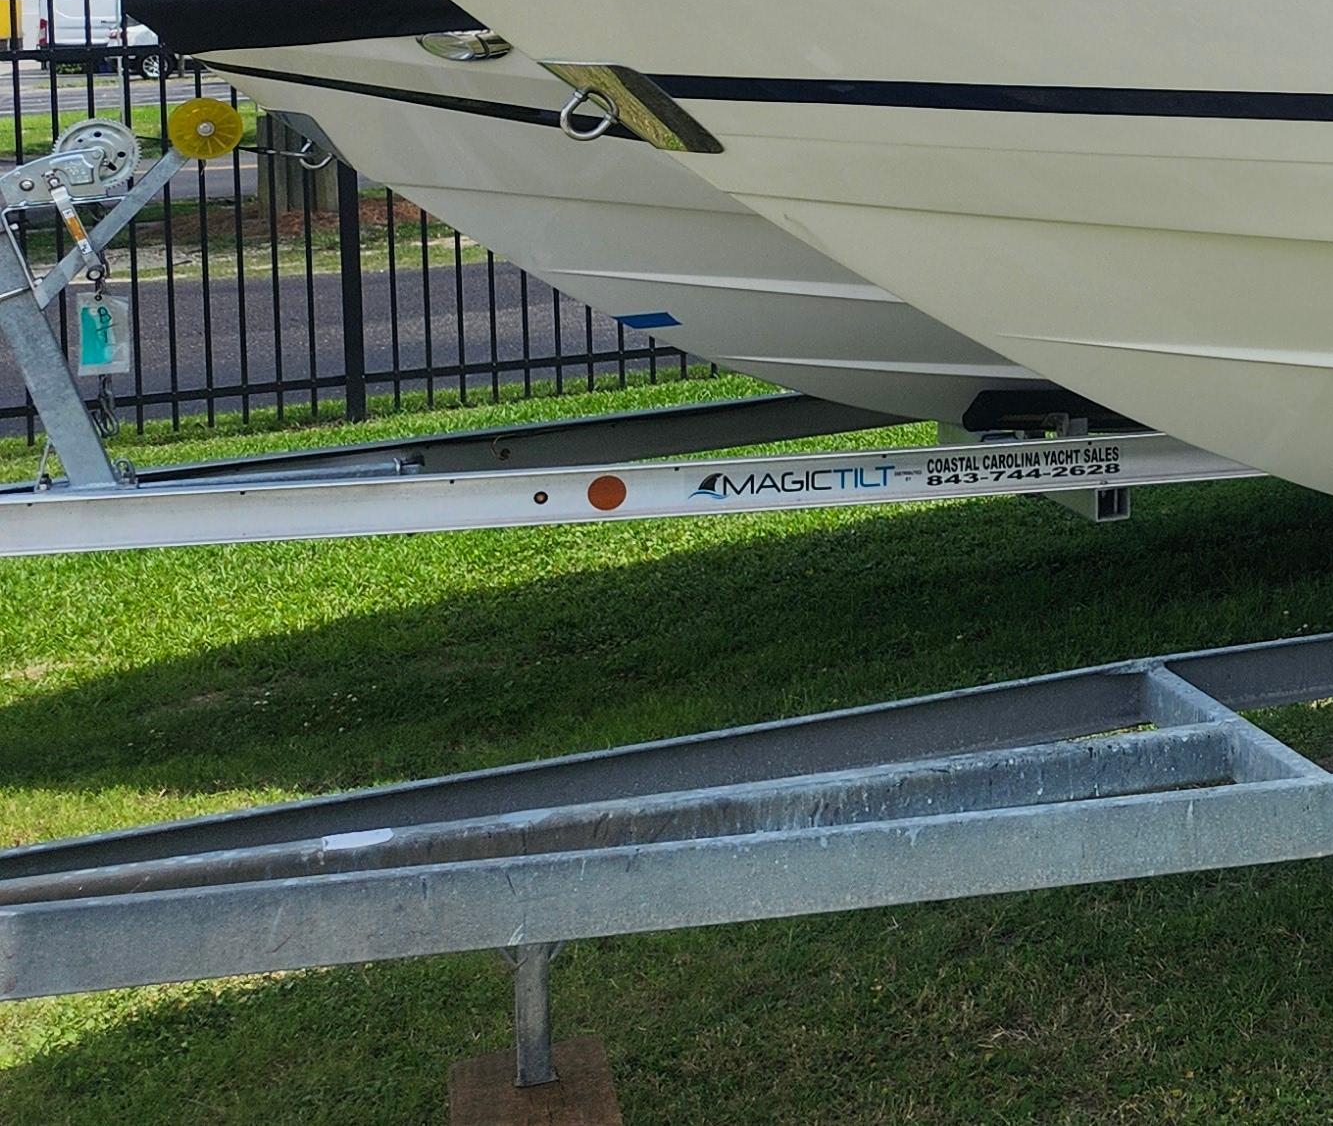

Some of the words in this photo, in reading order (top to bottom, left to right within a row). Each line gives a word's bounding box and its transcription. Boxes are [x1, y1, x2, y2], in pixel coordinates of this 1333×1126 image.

[927, 456, 979, 474] COASTAL
[983, 452, 1040, 470] CAROLINA
[1043, 449, 1080, 466] YACHT
[1084, 447, 1119, 463] SALES
[722, 465, 895, 495] MAGICTILT
[927, 463, 1120, 486] 843-744-2628
